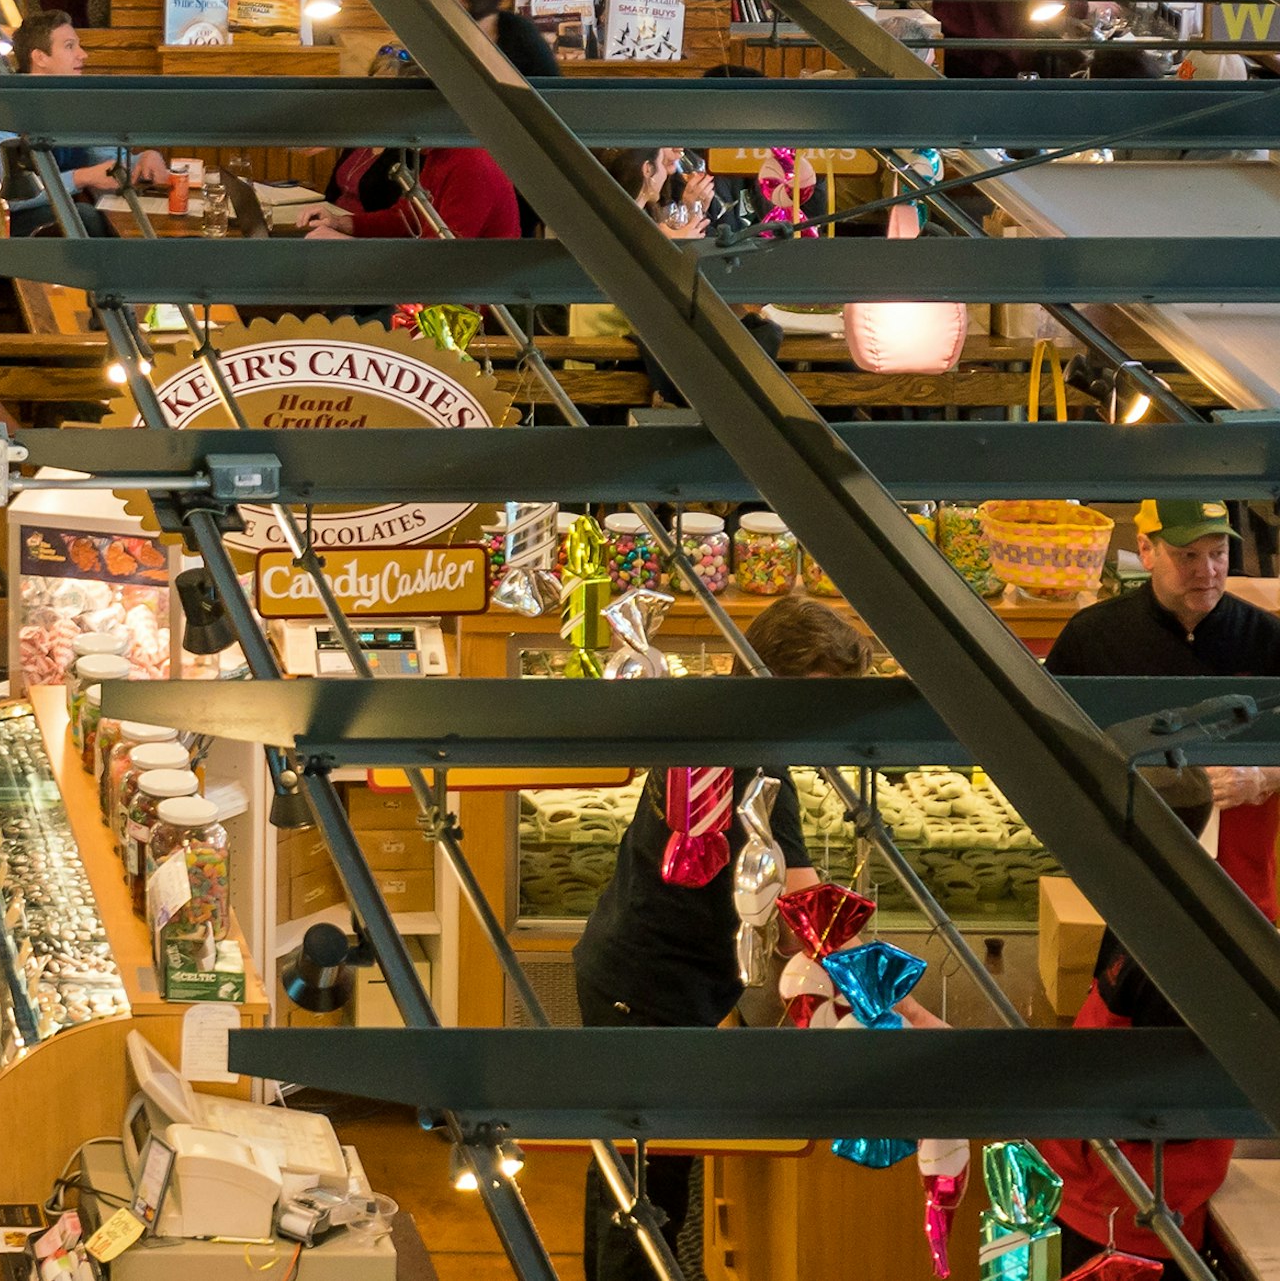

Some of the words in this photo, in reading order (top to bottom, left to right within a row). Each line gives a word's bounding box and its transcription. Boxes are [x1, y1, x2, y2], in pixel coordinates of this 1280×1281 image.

[618, 4, 649, 14] SMART
[652, 9, 676, 18] BUYS
[162, 350, 298, 420] KEHR'S
[308, 350, 475, 429] CANDIES
[278, 394, 355, 412] Hand
[263, 412, 368, 429] Crafted
[381, 549, 475, 605] Cashier
